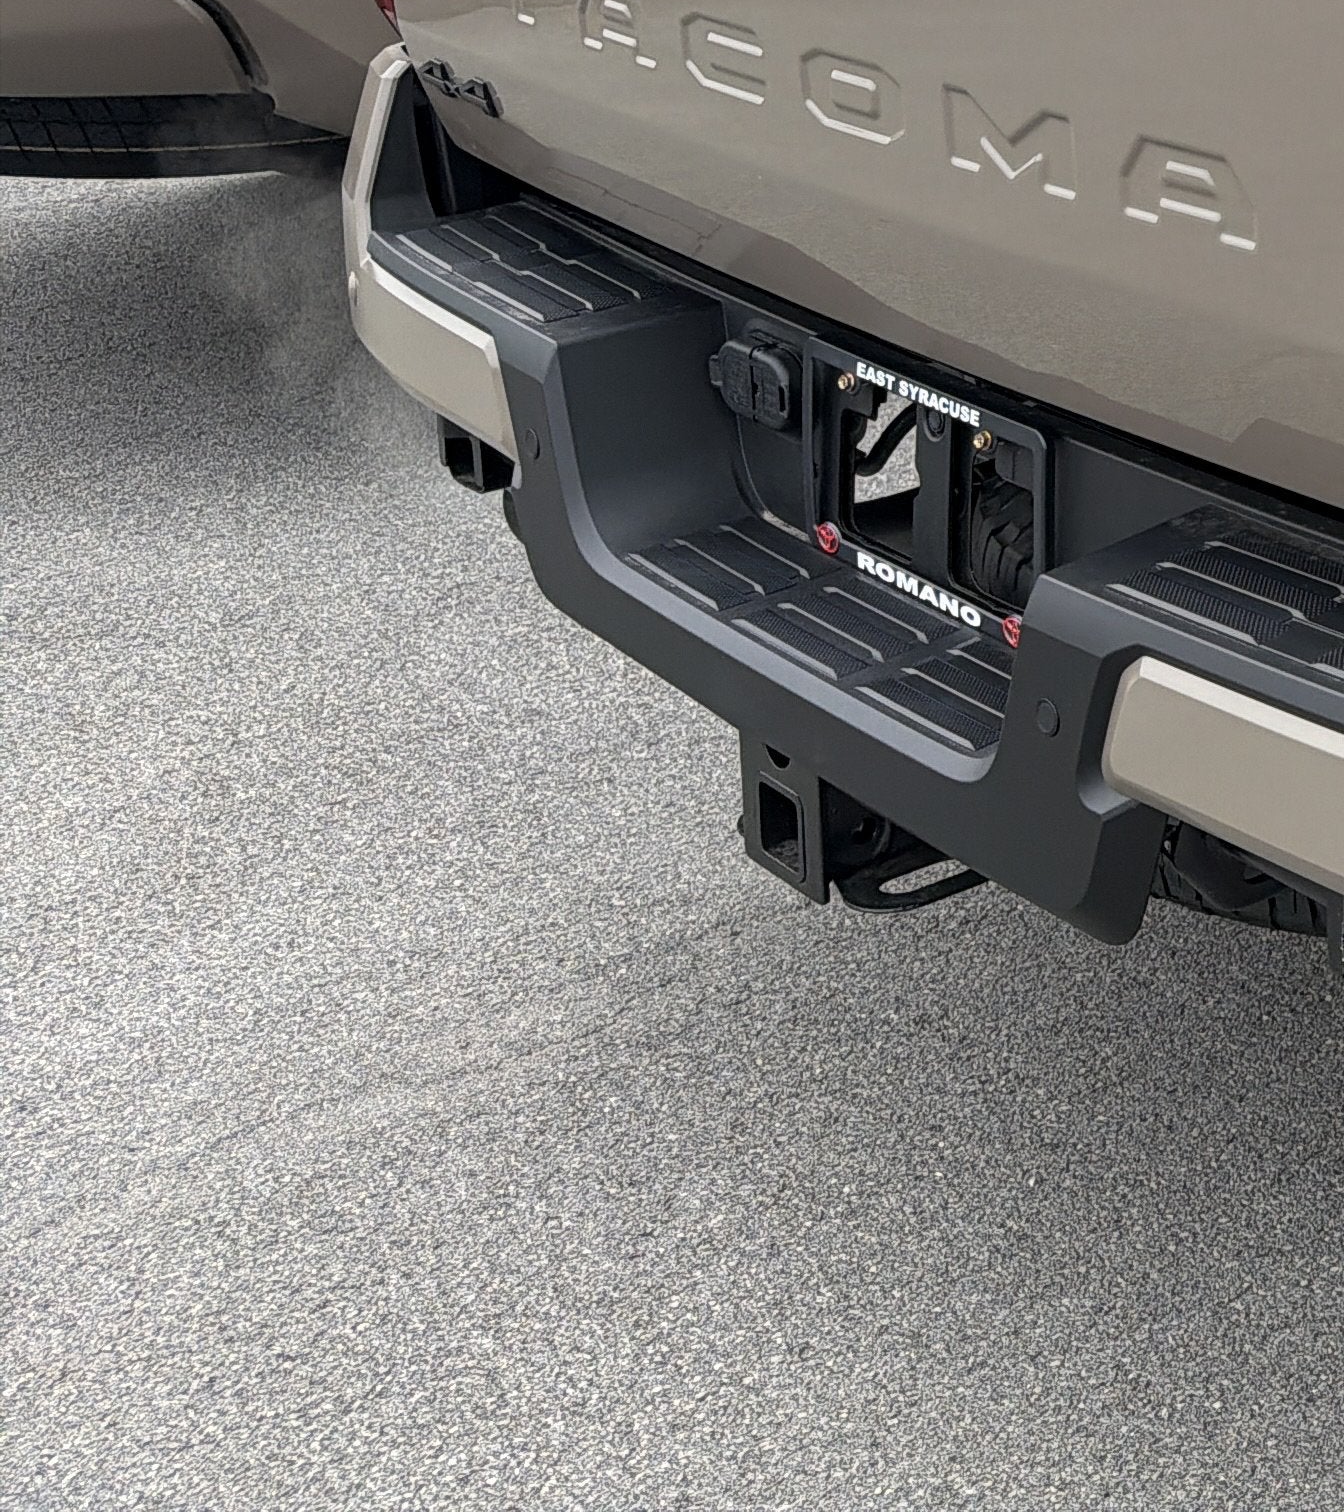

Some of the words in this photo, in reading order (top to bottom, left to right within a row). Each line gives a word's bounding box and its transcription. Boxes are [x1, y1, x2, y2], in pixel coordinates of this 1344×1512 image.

[856, 361, 896, 395] EAST
[899, 379, 981, 428] SYRACUSE
[857, 550, 982, 628] ROMANO
